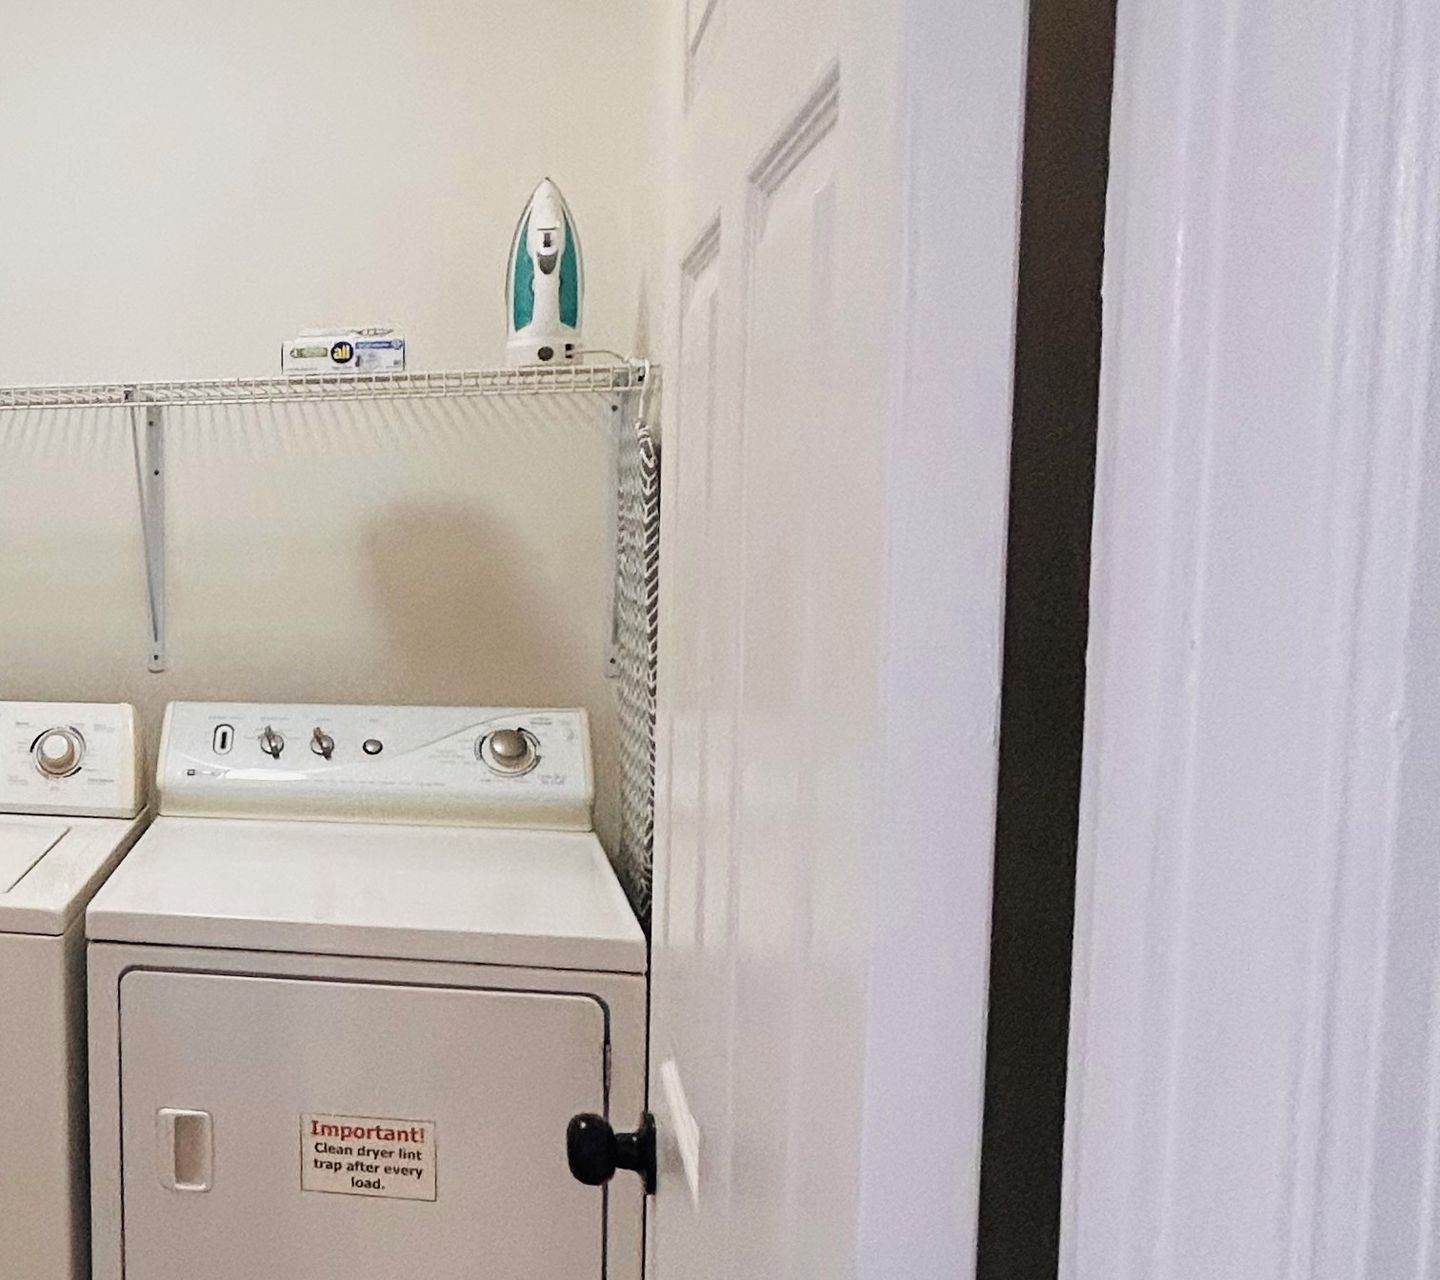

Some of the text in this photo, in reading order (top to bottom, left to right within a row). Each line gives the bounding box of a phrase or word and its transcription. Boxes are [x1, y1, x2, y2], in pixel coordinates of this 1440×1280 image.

[333, 345, 350, 360] all
[310, 1120, 425, 1144] Important!
[314, 1142, 422, 1161] Clean dryer lint
[313, 1158, 423, 1179] trap after every
[351, 1177, 386, 1190] load.
